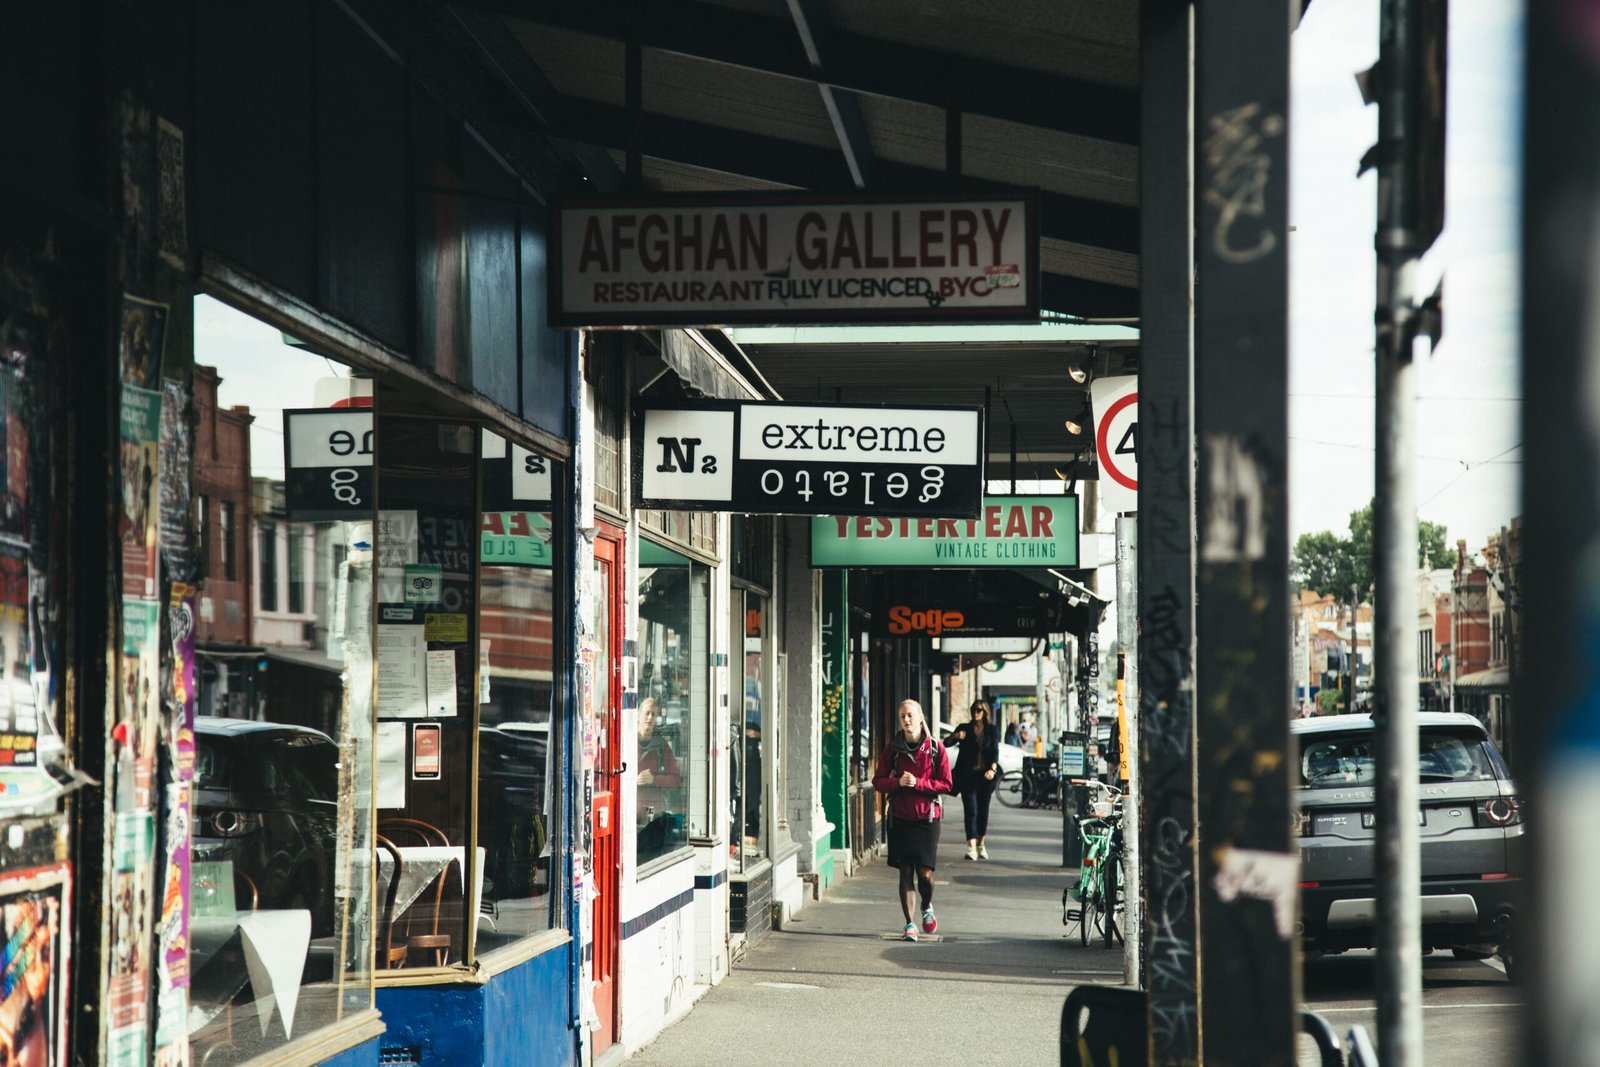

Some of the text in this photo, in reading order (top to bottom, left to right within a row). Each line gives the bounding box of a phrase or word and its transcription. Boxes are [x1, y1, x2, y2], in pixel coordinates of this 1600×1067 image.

[578, 208, 1012, 272] AFGHAN GALLERY
[593, 280, 765, 303] RESTAURANT
[768, 278, 822, 300] FULLY
[828, 276, 932, 298] LICENCED
[761, 418, 945, 453] extreme
[761, 465, 945, 505] gelato
[935, 542, 1057, 559] VINTAGE CLOTHING
[889, 605, 965, 636] Sogo
